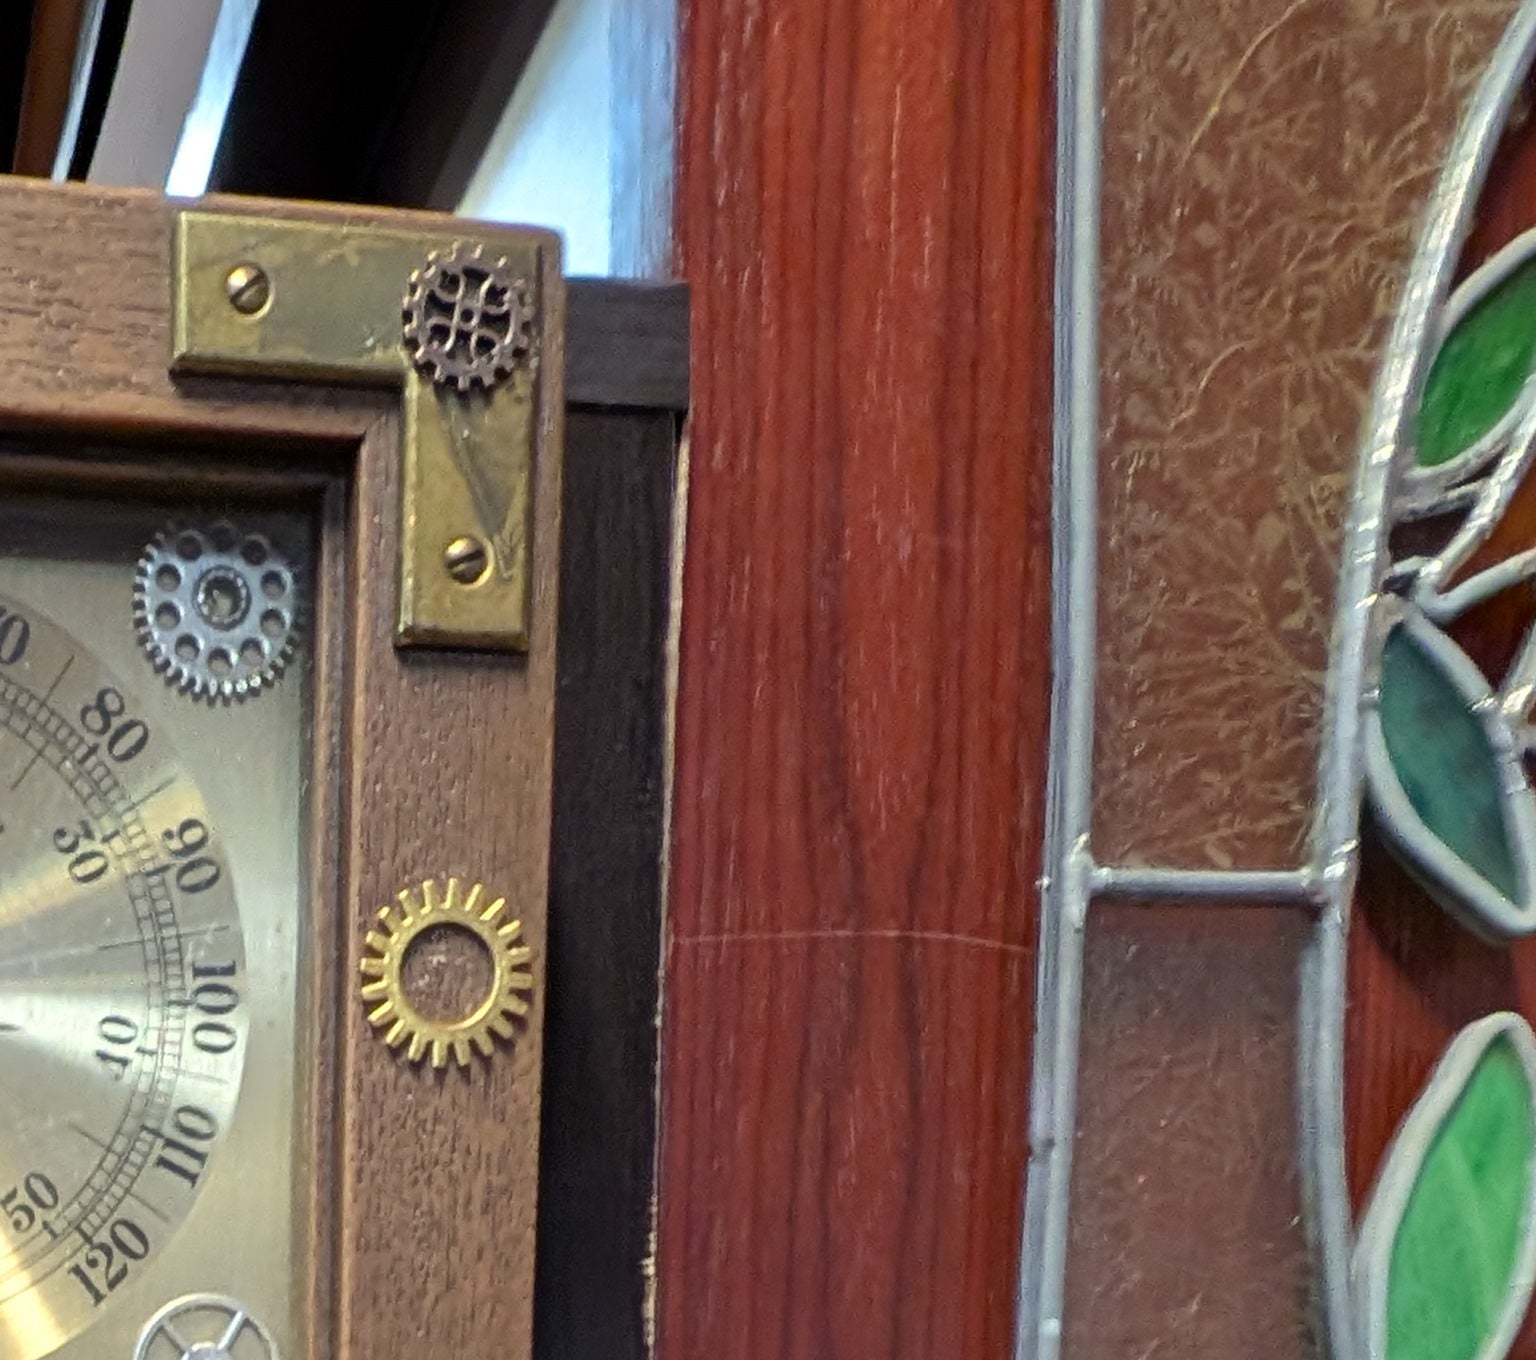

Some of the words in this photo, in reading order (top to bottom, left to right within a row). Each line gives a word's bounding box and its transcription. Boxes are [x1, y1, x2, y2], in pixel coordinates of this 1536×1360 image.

[79, 686, 150, 763] 80
[52, 819, 110, 885] 30
[161, 817, 222, 894] 90
[191, 960, 240, 1055] 100
[95, 1016, 139, 1081] 40
[156, 1104, 219, 1188] 110
[0, 1171, 60, 1233] 50
[67, 1218, 151, 1307] 120
